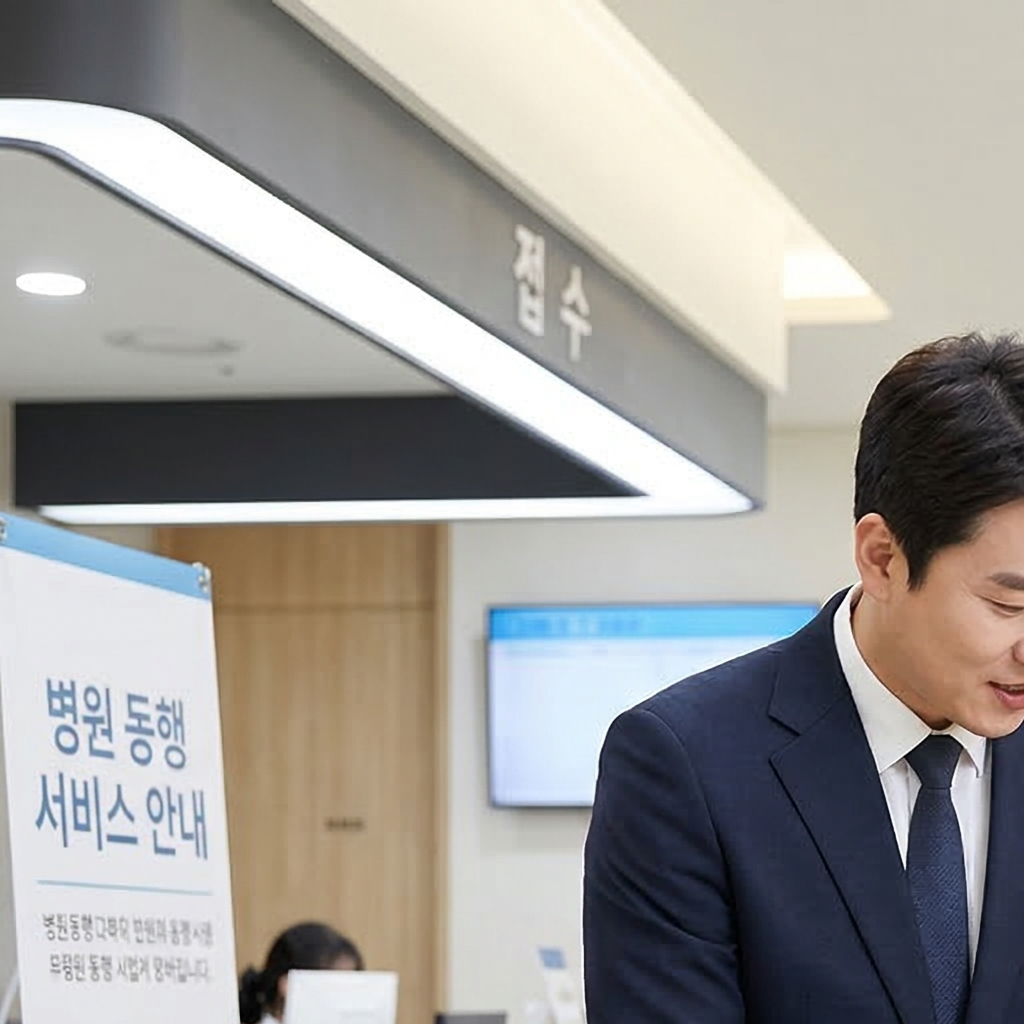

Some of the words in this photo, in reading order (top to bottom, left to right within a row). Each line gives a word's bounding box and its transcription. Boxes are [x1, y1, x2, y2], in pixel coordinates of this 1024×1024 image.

[513, 223, 592, 363] 접수
[46, 678, 115, 760] 병원
[124, 691, 187, 769] 동행
[35, 771, 138, 852] 서비스
[147, 786, 208, 860] 안내
